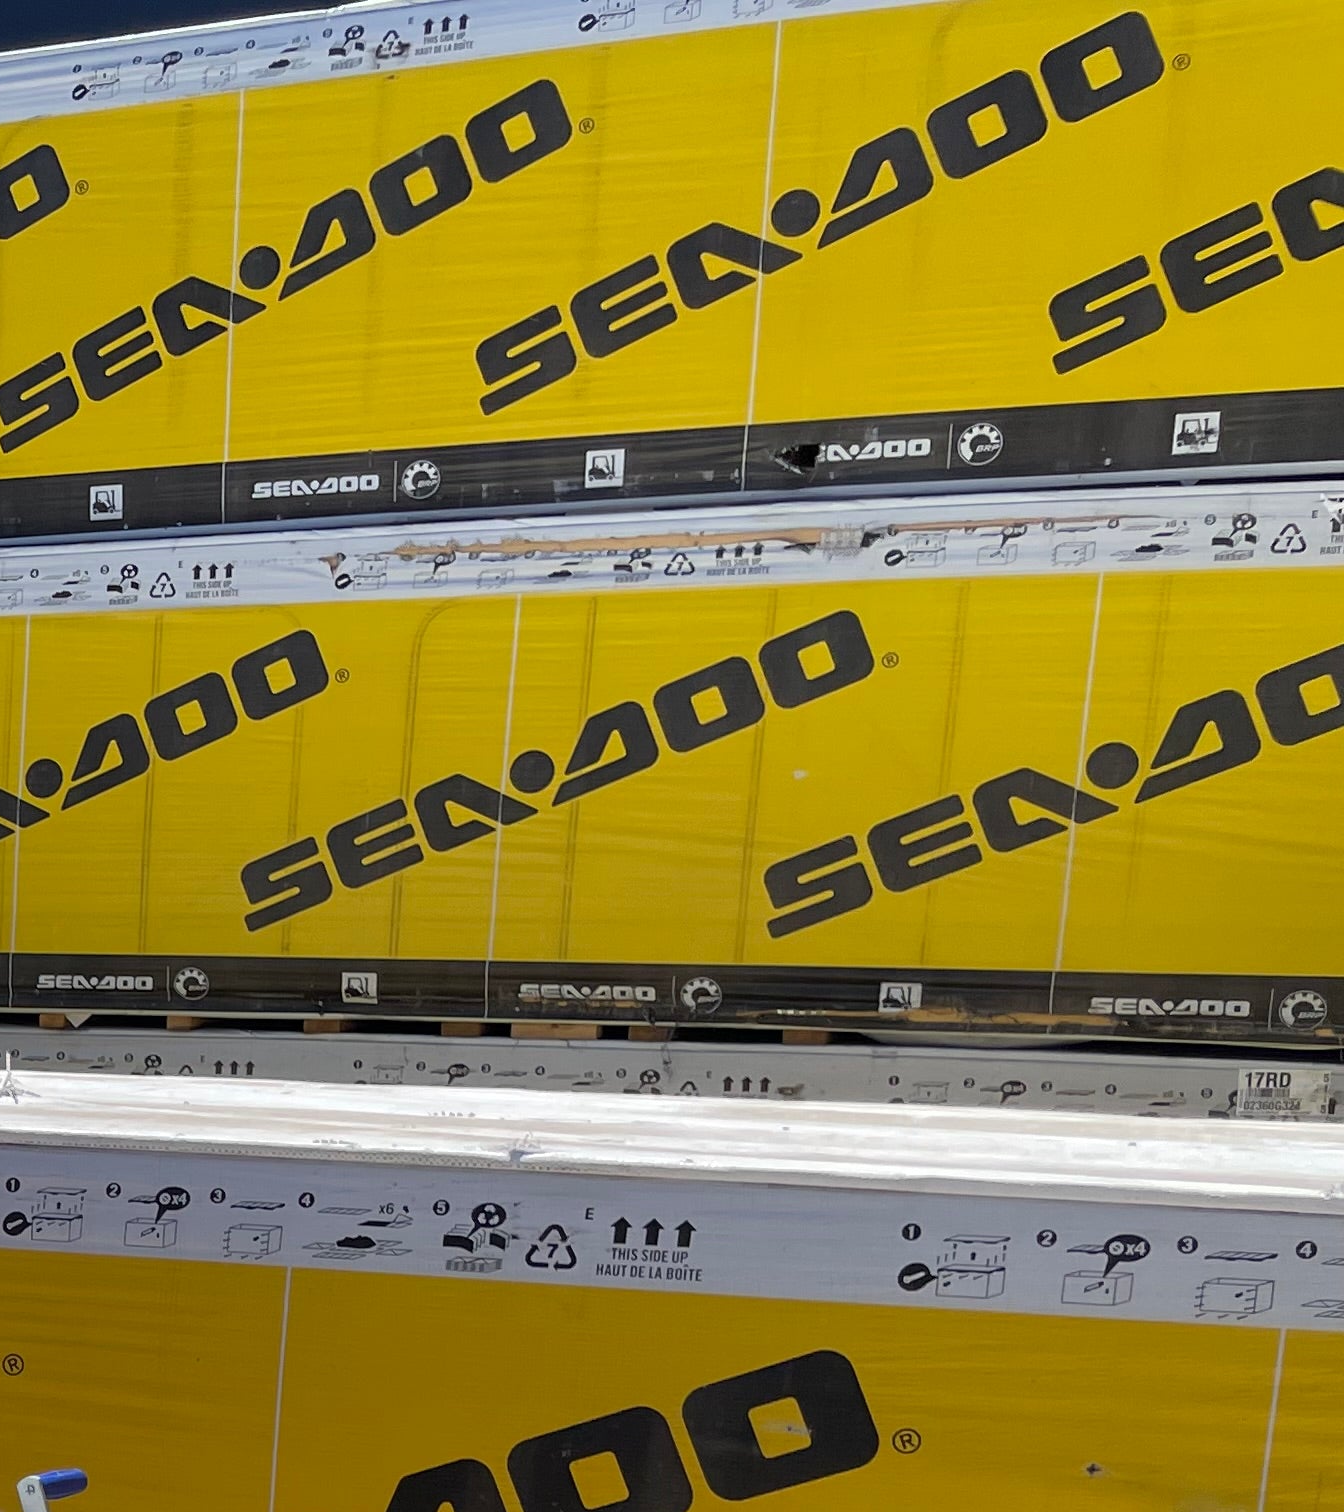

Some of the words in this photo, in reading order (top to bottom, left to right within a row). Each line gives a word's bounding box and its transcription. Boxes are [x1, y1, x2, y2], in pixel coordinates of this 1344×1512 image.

[1245, 1072, 1291, 1088] 17RD
[612, 1247, 638, 1262] THIS
[642, 1248, 668, 1263] SIDE
[671, 1250, 689, 1264] UP
[596, 1263, 627, 1278] HAUT
[630, 1265, 645, 1279] DE
[648, 1266, 662, 1280] LA
